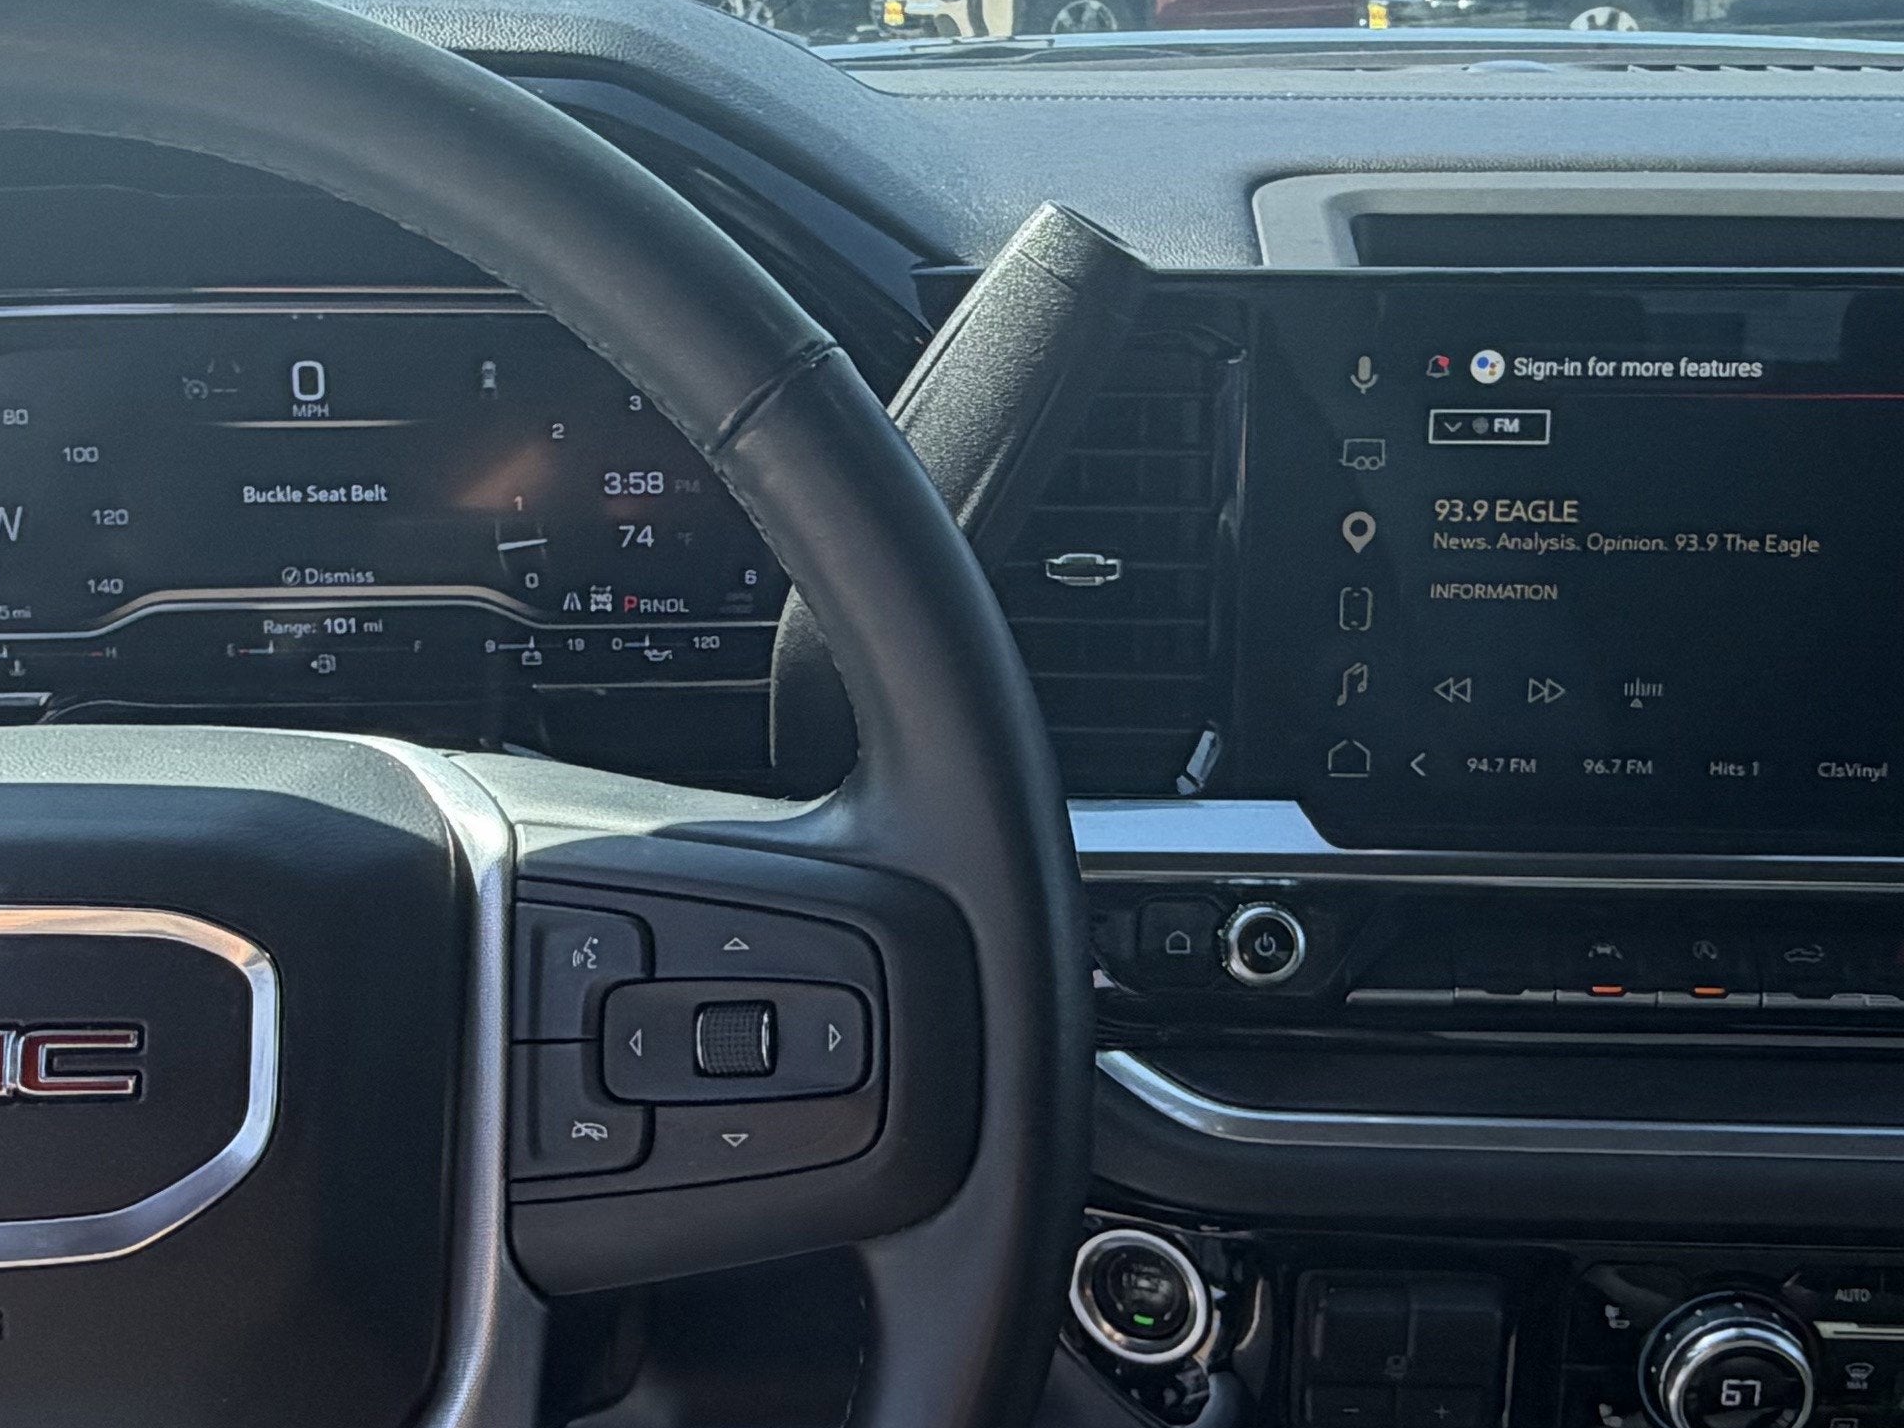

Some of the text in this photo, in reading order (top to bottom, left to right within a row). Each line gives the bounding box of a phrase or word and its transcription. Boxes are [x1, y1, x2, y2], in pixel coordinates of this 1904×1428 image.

[1514, 356, 1762, 380] Sign-in for more features
[291, 359, 326, 402] 0
[292, 403, 330, 418] MPH
[629, 395, 642, 411] 3
[2, 408, 29, 426] 80
[1493, 418, 1520, 433] FM
[551, 422, 565, 439] 2
[61, 446, 100, 463] 100
[603, 471, 665, 495] 3:58
[242, 484, 389, 504] Buckle Seat Belt
[514, 495, 523, 512] 1
[1433, 499, 1579, 523] 93.9 EAGLE
[91, 508, 130, 526] 120
[618, 525, 655, 548] 74
[1432, 532, 1820, 558] News. Analysis. Opinion. 93.9 The Eagle
[304, 567, 375, 585] Dismiss
[524, 572, 539, 589] 0
[744, 569, 757, 585] 6
[86, 577, 125, 595] 140
[1430, 583, 1558, 600] INFORMATION
[262, 617, 384, 639] Range: 101 mi
[611, 637, 623, 651] 0
[1466, 758, 1537, 773] 94.7 FM
[1583, 759, 1653, 775] 96.7 FM
[1709, 761, 1746, 777] Hits
[1834, 1288, 1872, 1303] AUTO
[1719, 1378, 1762, 1406] 67
